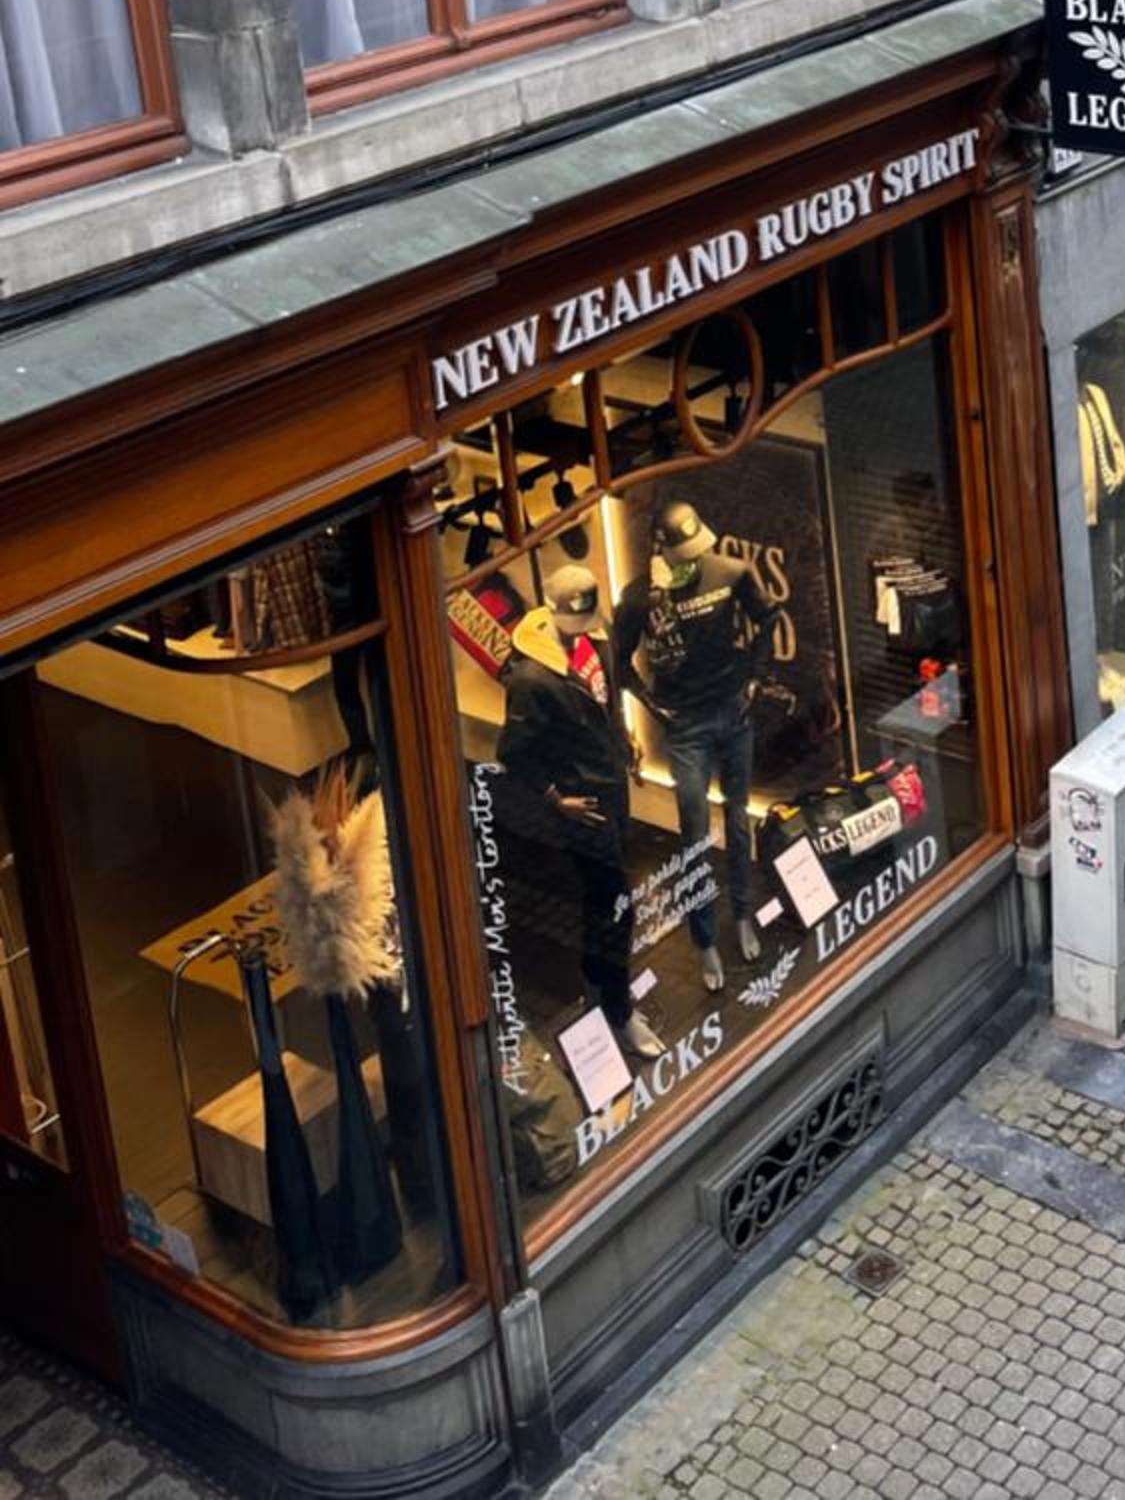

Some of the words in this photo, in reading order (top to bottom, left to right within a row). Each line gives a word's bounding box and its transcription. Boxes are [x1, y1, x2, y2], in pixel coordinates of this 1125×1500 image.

[432, 314, 539, 409] NEW
[553, 228, 748, 353] ZEALAND
[757, 171, 876, 260] RUGBY
[883, 129, 979, 204] SPIRIT
[470, 761, 506, 877] territory
[848, 805, 896, 842] LEGEND
[482, 876, 512, 953] Men's
[815, 834, 938, 962] LEGEND
[575, 1011, 724, 1167] BLACKS
